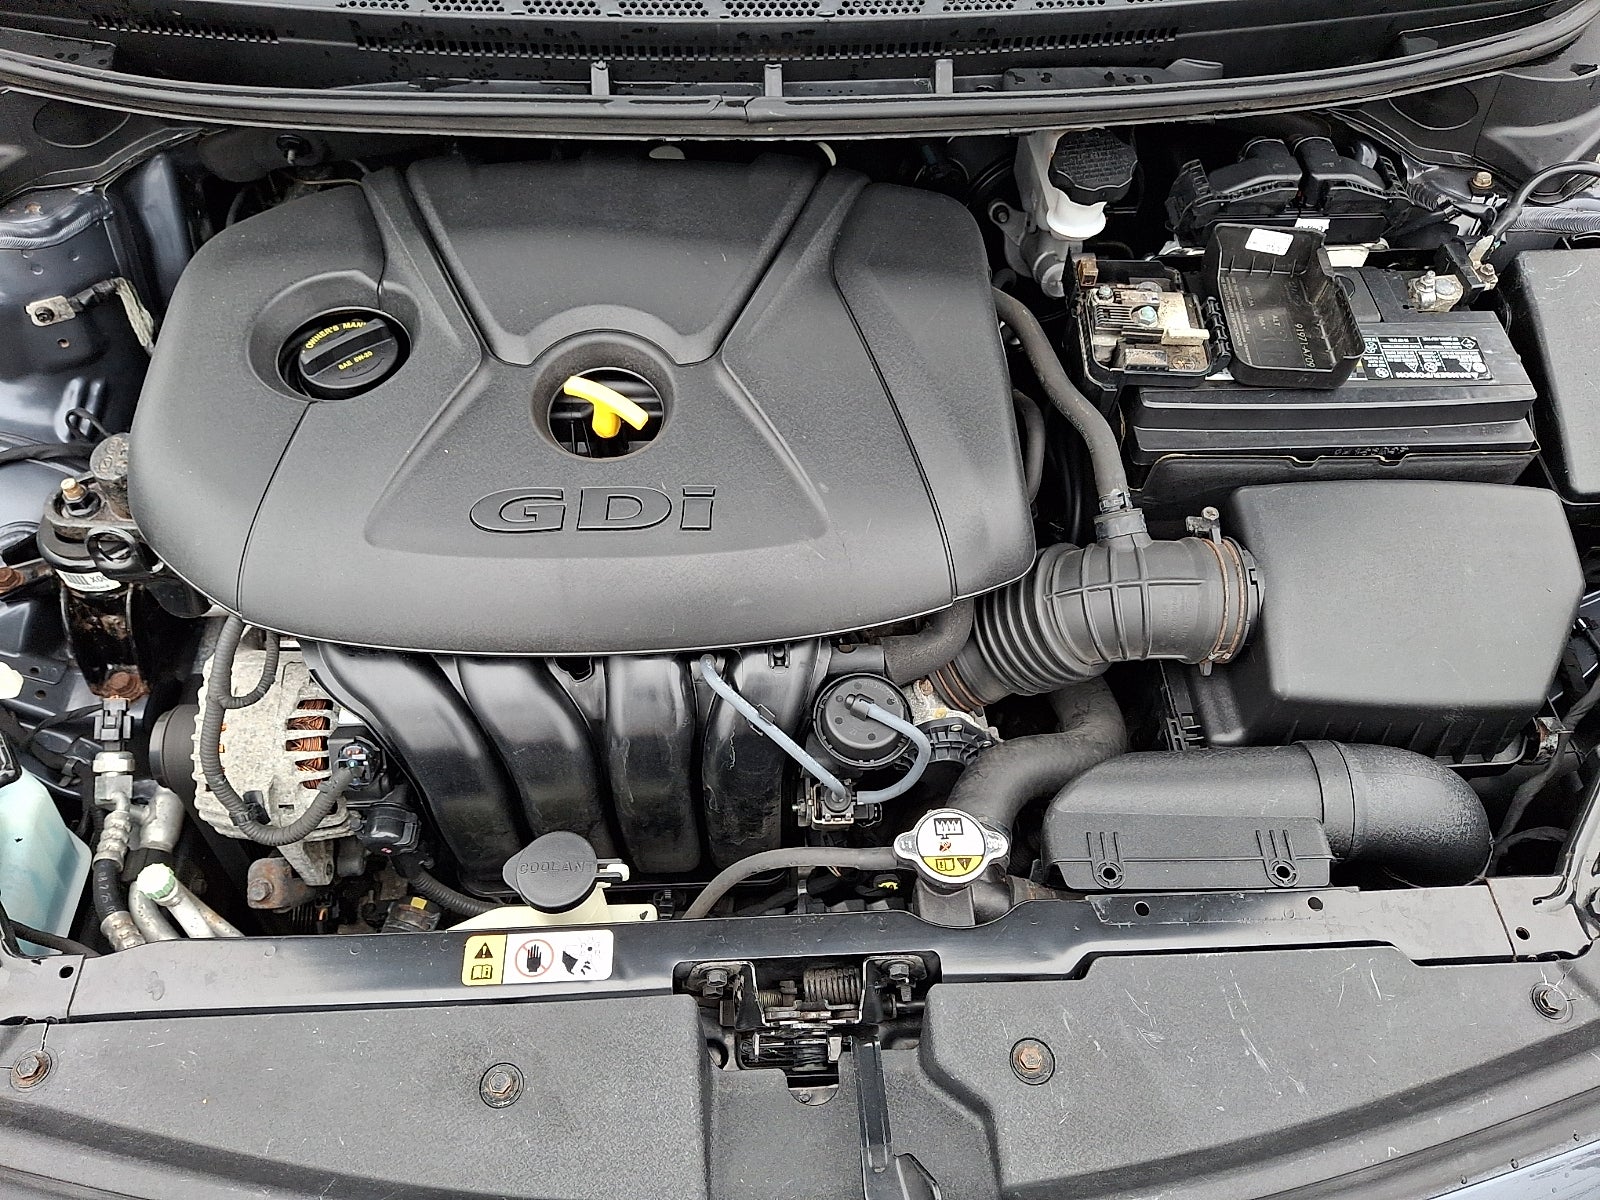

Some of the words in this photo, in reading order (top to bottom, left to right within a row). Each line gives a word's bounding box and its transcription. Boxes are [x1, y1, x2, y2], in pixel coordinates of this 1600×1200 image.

[305, 325, 340, 349] OWNER'S
[342, 321, 367, 330] MAN
[338, 360, 353, 370] SAE
[468, 484, 718, 533] GDi
[520, 860, 595, 875] COOLANT
